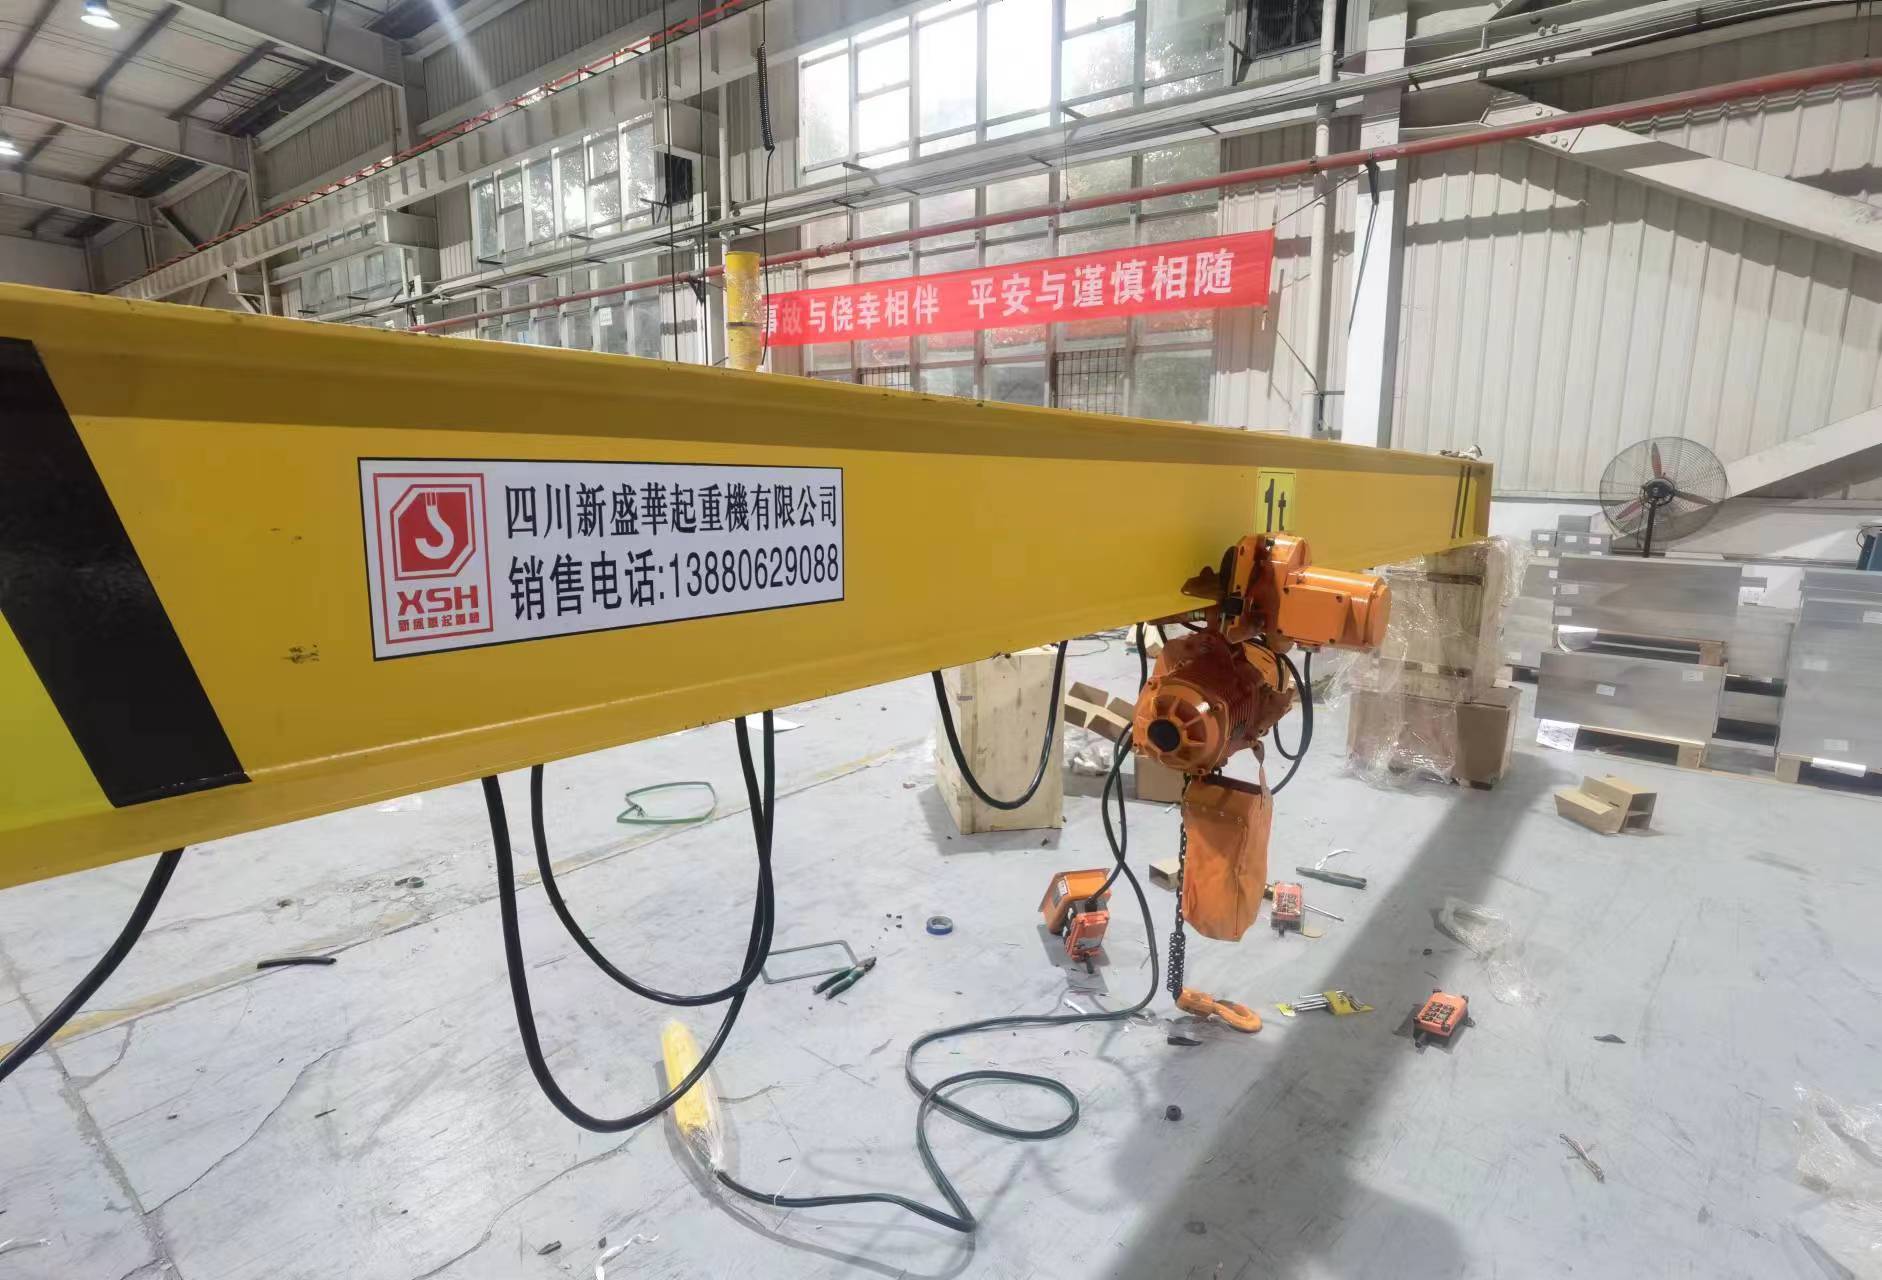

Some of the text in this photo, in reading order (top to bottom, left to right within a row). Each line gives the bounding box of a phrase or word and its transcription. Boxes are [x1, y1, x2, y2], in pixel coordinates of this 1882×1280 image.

[968, 249, 1234, 312] 平安与谨慎相随
[505, 482, 837, 539] 四川新盛華起重機有限公司
[396, 585, 479, 616] XSH
